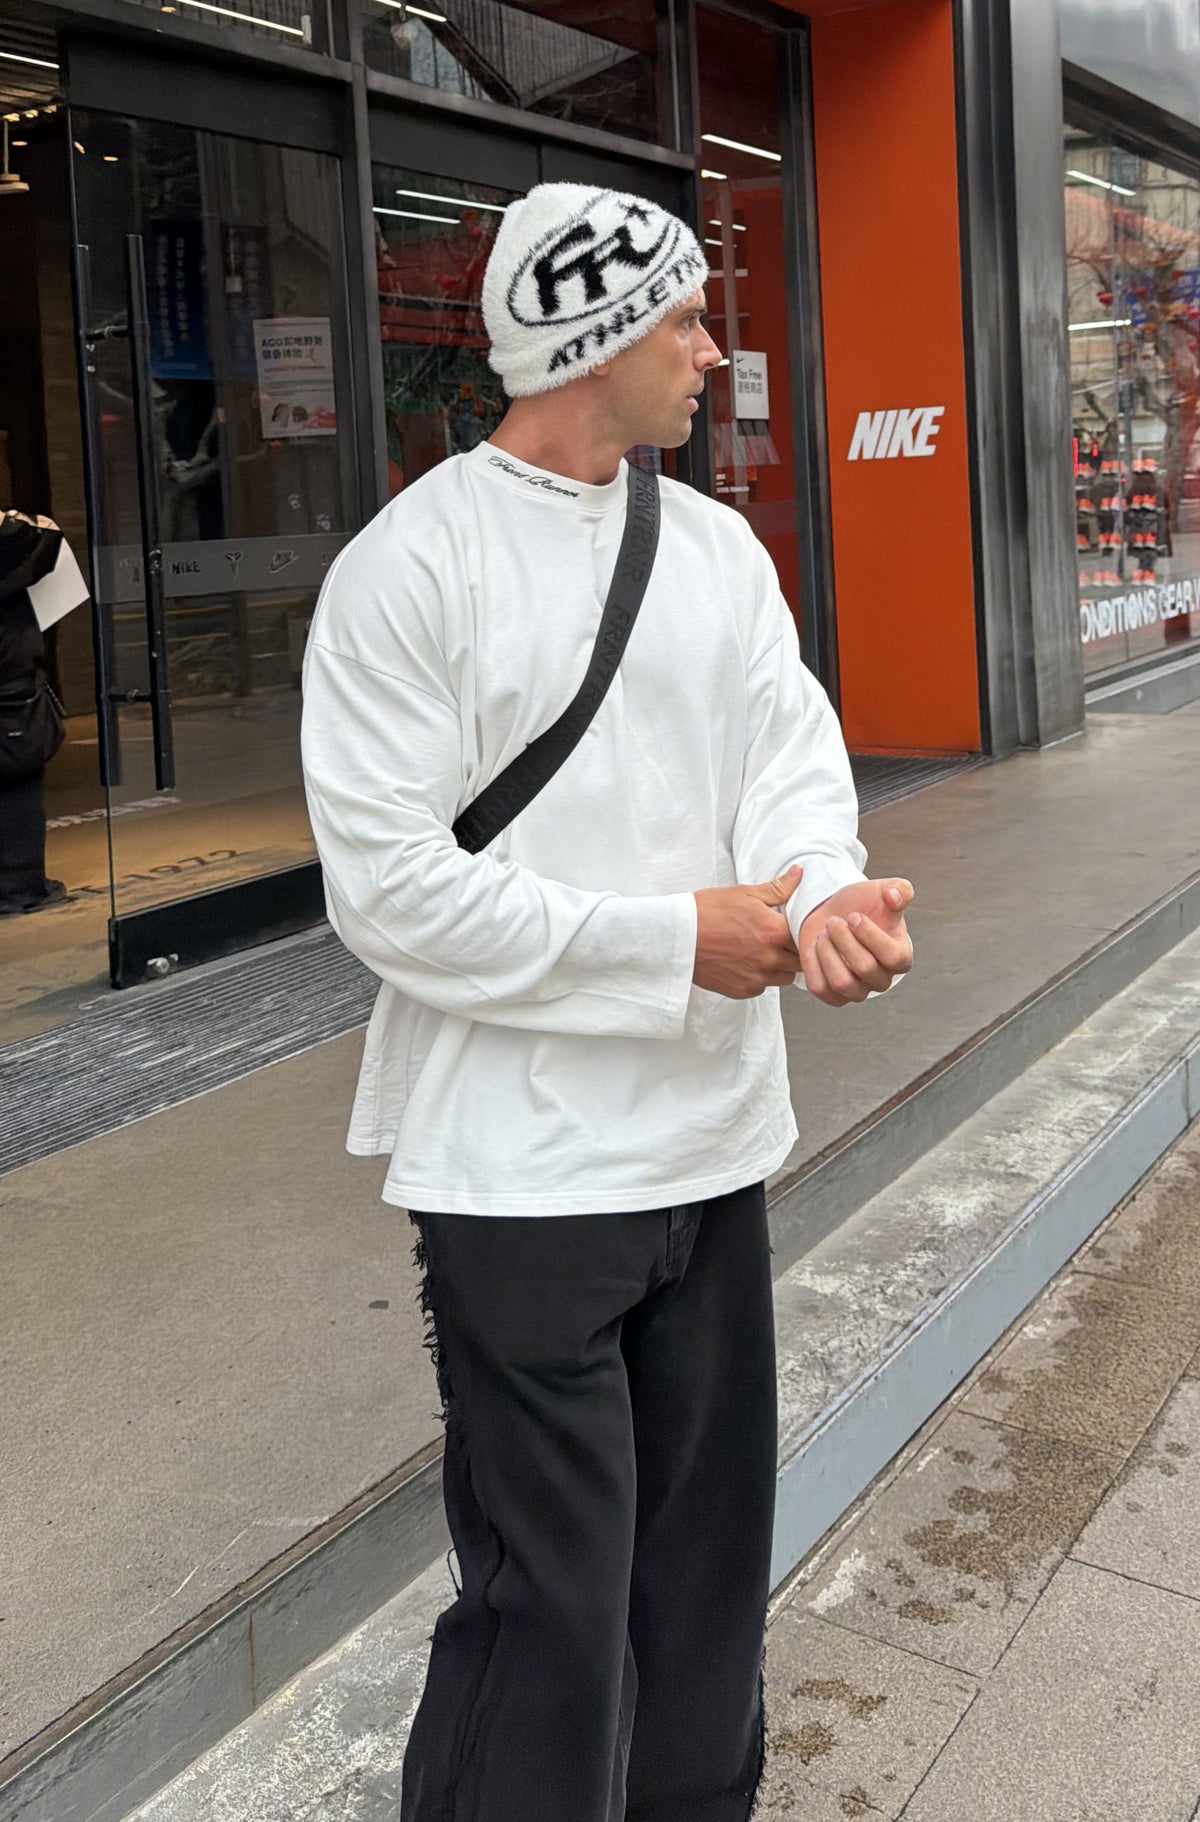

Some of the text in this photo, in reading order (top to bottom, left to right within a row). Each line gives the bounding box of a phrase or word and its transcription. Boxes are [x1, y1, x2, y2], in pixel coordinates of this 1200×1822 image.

[737, 368, 762, 380] Tax Free
[847, 406, 945, 461] NIKE
[171, 560, 201, 575] NIKE
[1080, 588, 1158, 644] ONDITIONS
